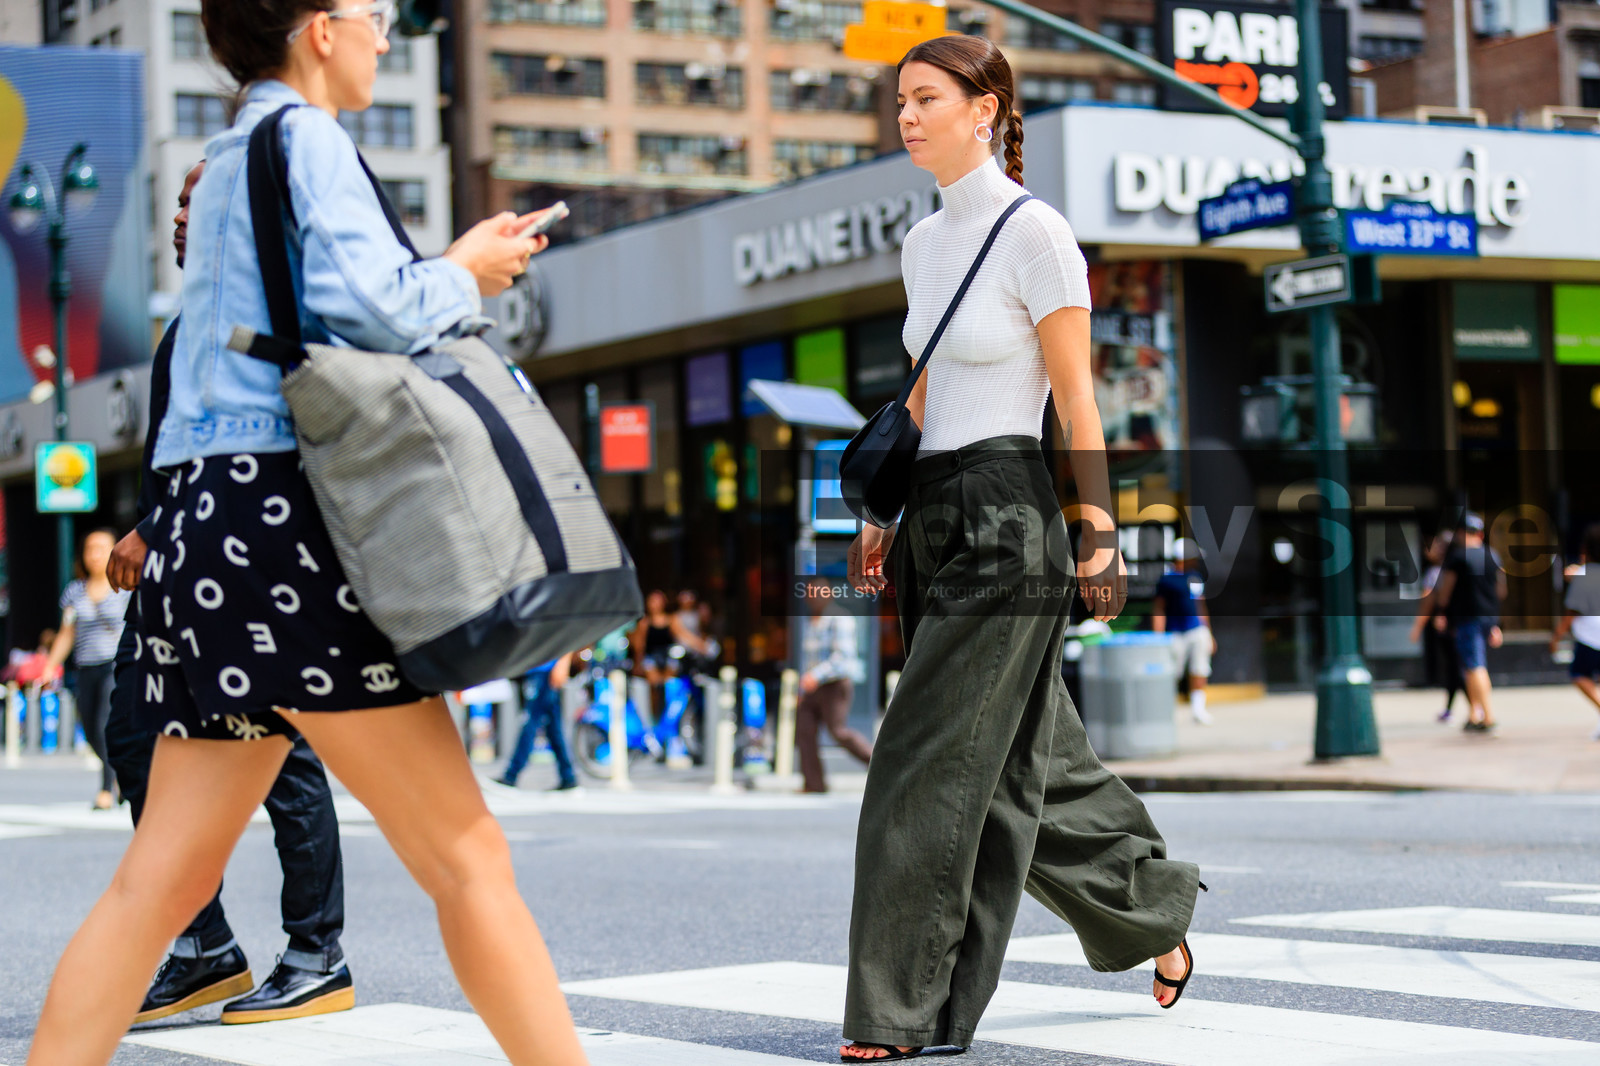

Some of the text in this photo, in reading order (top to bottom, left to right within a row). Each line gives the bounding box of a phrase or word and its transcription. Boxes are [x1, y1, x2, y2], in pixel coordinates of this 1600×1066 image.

[1331, 144, 1530, 228] reade
[1203, 192, 1289, 234] Eighth Ave
[1352, 217, 1406, 247] West
[1447, 219, 1472, 249] St
